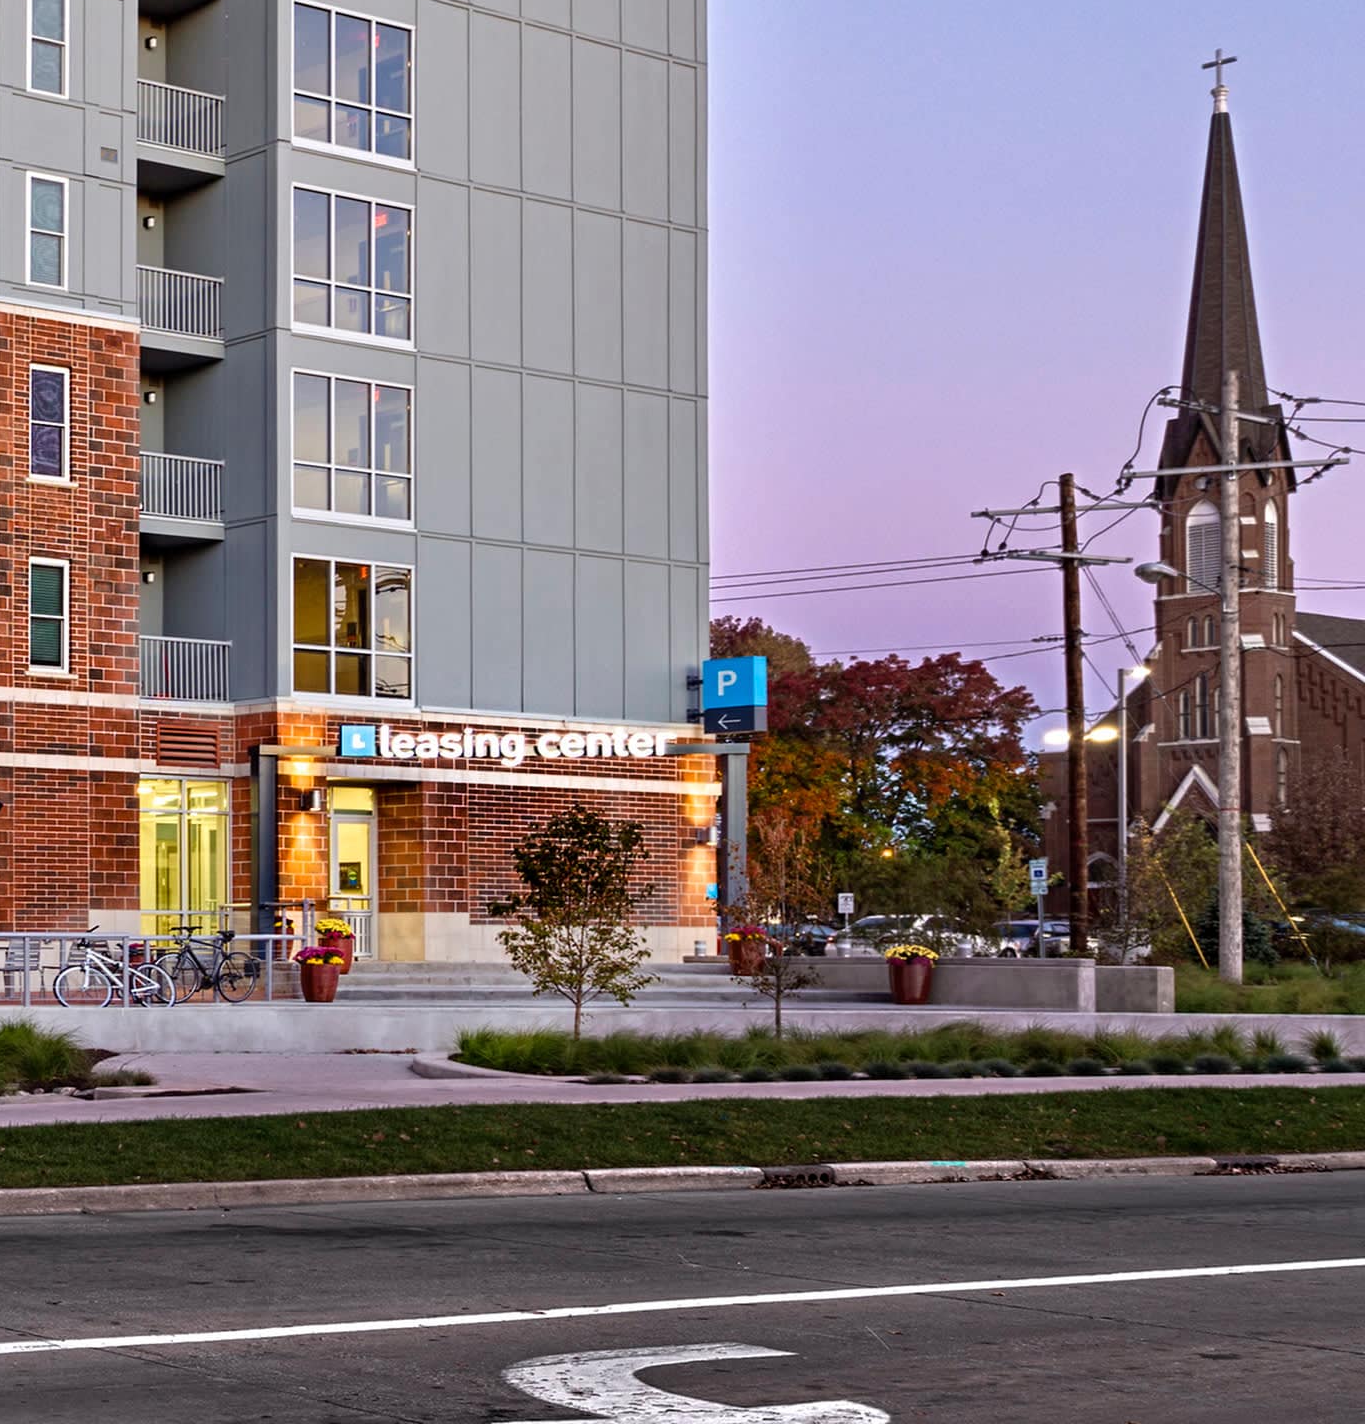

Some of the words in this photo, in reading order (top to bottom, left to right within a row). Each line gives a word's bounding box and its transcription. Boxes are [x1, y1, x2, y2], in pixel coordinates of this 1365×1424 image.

[717, 670, 738, 697] P
[379, 724, 526, 766] leasing
[536, 727, 676, 758] center
